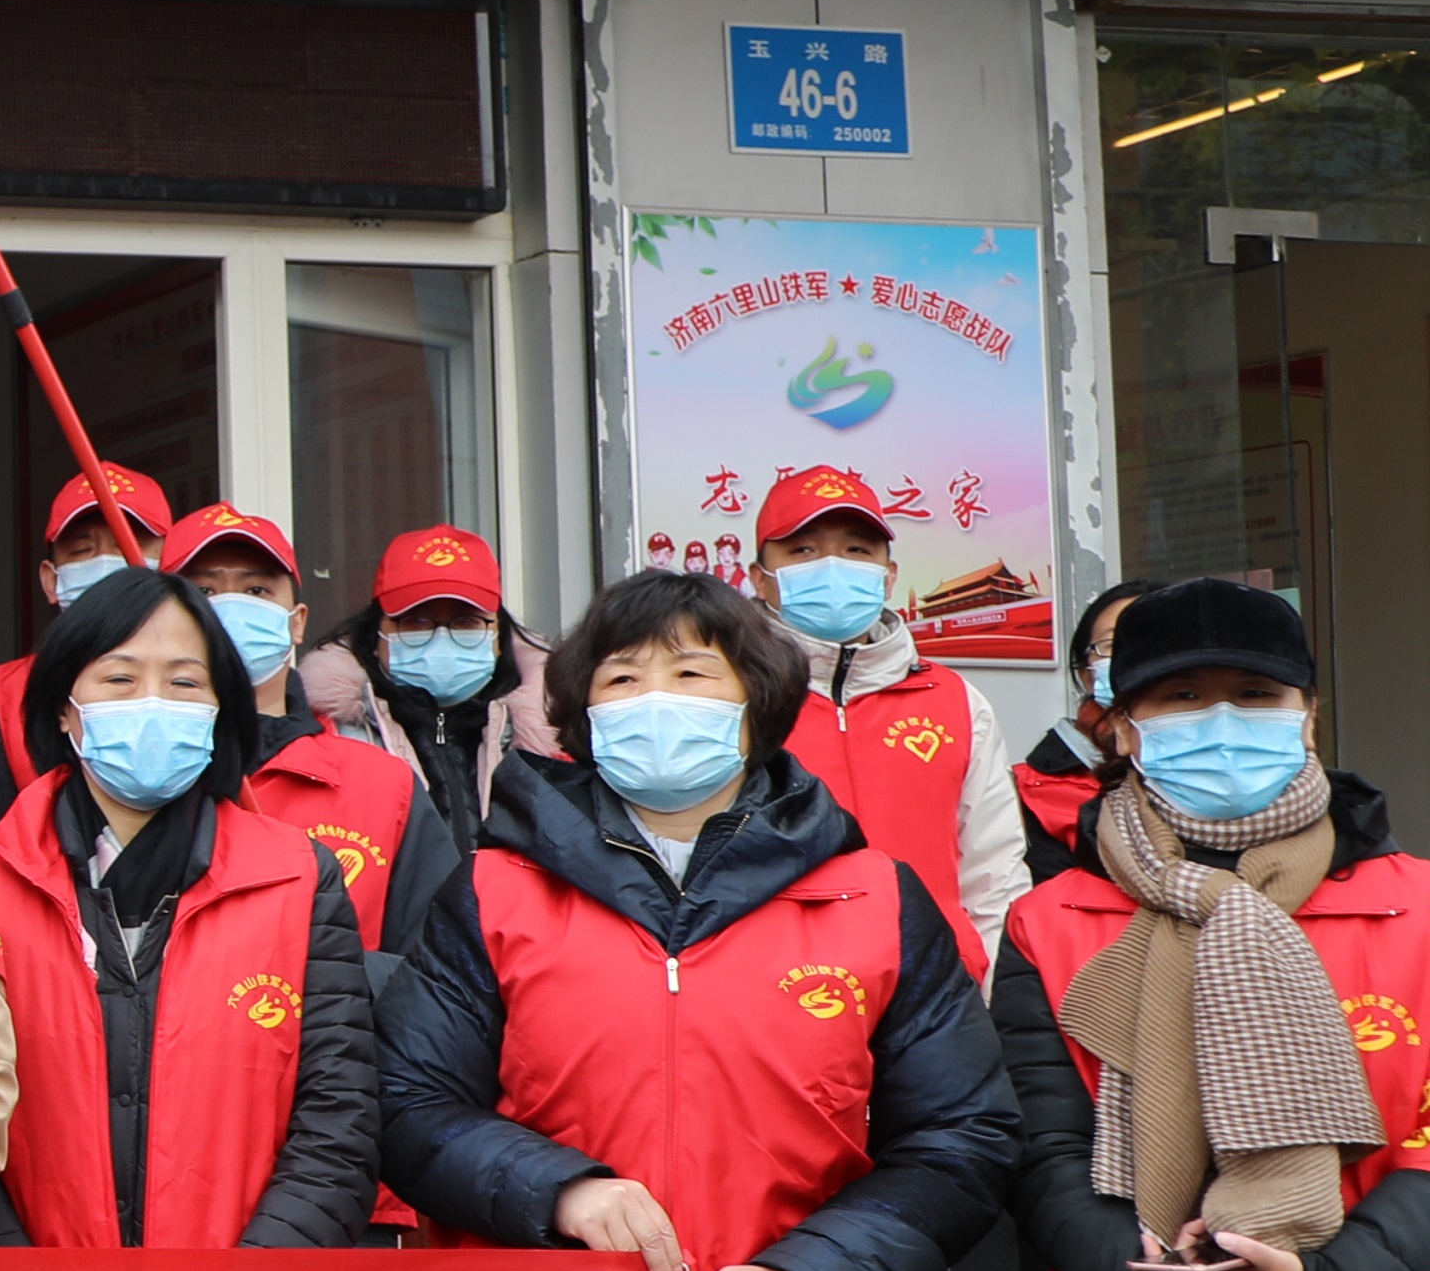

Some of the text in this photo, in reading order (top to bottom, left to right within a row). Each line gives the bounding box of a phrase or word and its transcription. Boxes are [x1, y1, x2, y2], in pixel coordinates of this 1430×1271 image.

[747, 40, 889, 64] 玉兴路
[778, 68, 859, 121] 46-6
[833, 127, 893, 143] 250002
[663, 271, 1013, 363] 济南六里山铁军 爱心志愿战队
